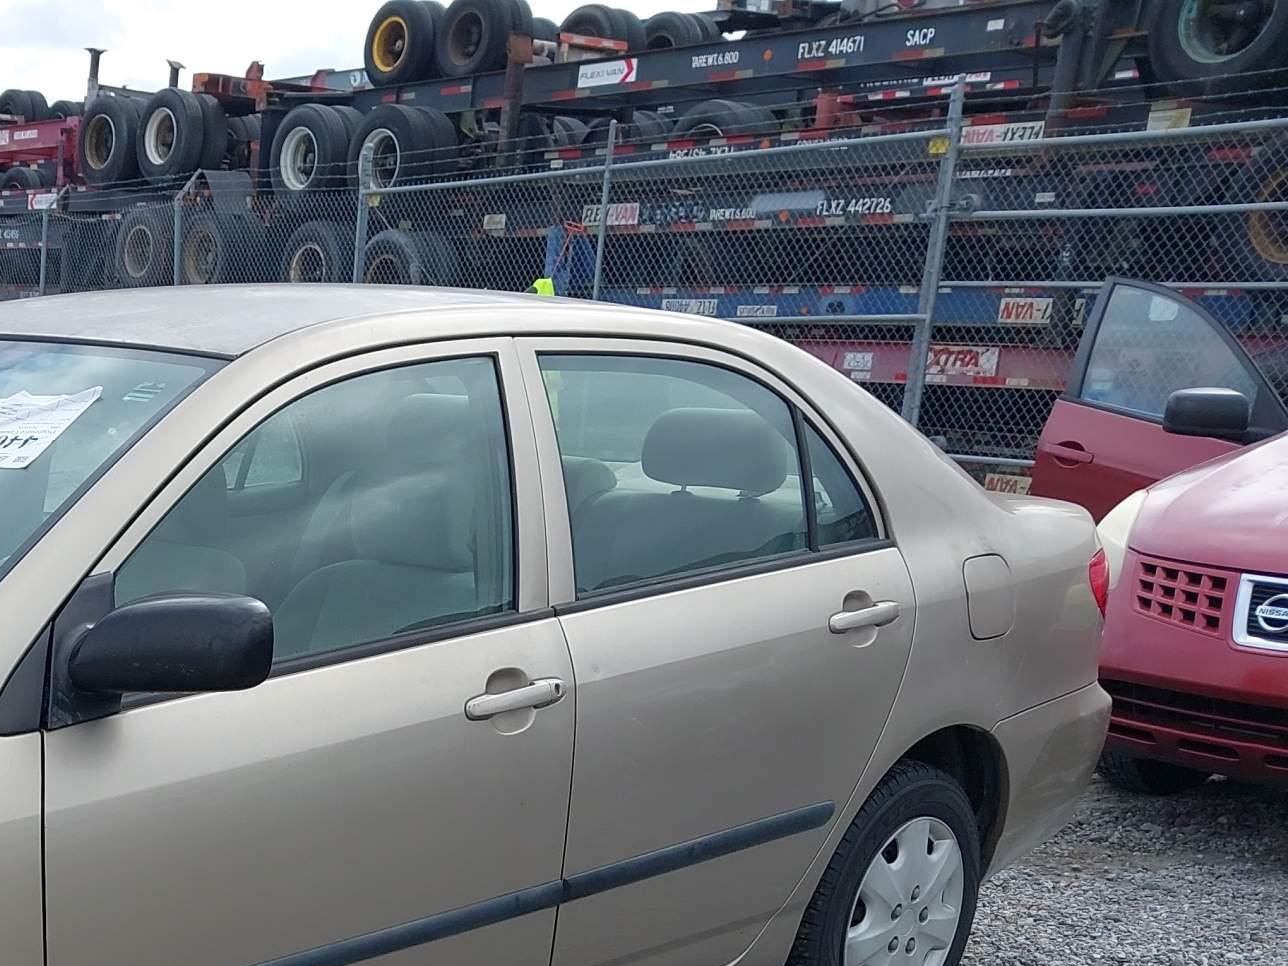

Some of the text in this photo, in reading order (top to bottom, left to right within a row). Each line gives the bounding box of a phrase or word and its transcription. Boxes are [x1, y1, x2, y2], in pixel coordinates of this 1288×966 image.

[798, 35, 864, 59] FLXZ 414671
[905, 27, 935, 47] SACP
[847, 197, 892, 214] 442726
